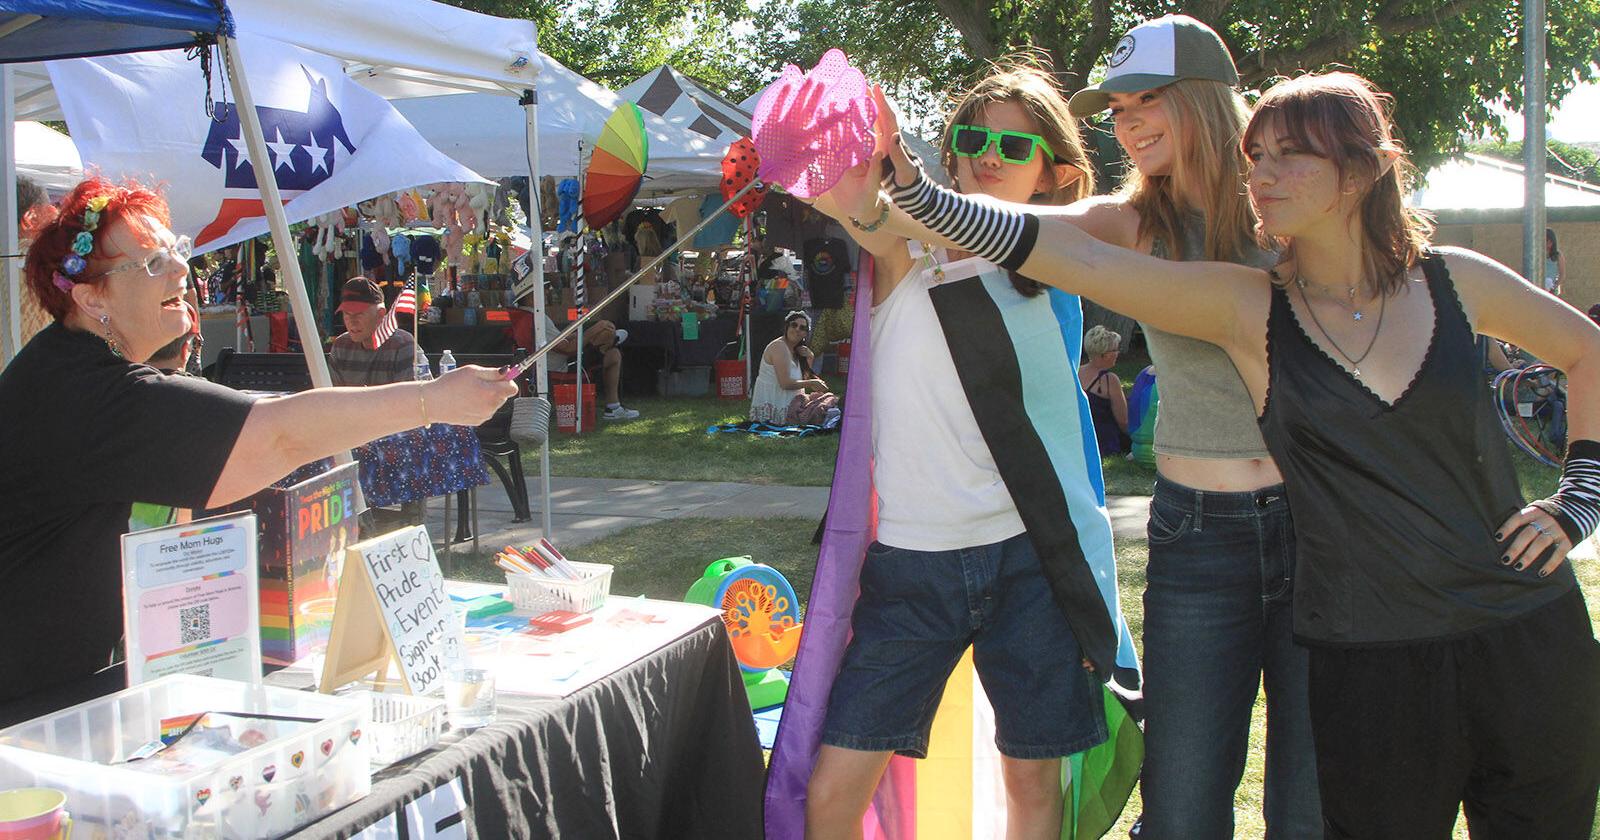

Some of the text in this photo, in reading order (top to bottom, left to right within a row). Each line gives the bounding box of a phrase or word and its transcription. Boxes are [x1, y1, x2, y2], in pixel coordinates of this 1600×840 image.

[298, 488, 353, 540] PRIDE
[160, 543, 178, 553] Free
[180, 540, 201, 551] Mom
[203, 535, 224, 546] Hugs
[366, 541, 409, 579] First
[376, 570, 421, 608] Pride
